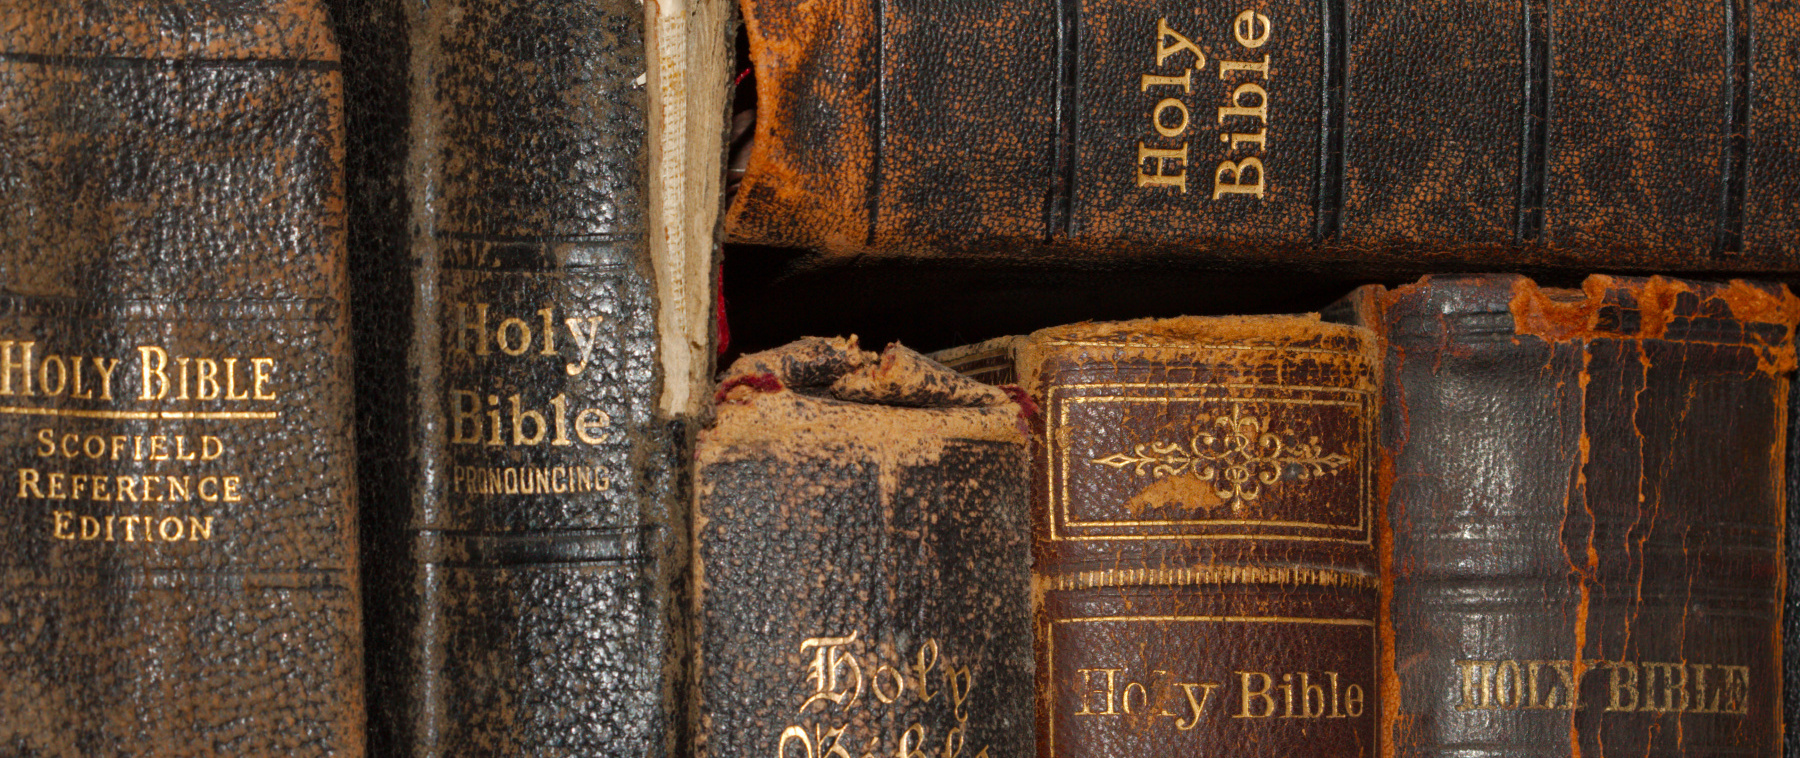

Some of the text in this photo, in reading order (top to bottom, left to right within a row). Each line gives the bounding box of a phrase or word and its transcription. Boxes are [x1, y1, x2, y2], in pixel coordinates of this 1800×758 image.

[1137, 17, 1206, 194] Holy
[1212, 9, 1271, 201] Bible
[454, 302, 603, 376] Holy
[0, 340, 277, 401] HOLY BIBLE
[37, 429, 223, 461] SCOFIELD
[451, 390, 611, 446] Bible
[17, 467, 242, 502] REFERENCE
[453, 464, 610, 495] PRONOUNCING
[53, 510, 214, 542] EDITION
[799, 629, 972, 723] Holy
[1074, 667, 1364, 731] Hoy Bible
[1454, 659, 1750, 715] HOLY BIBLE
